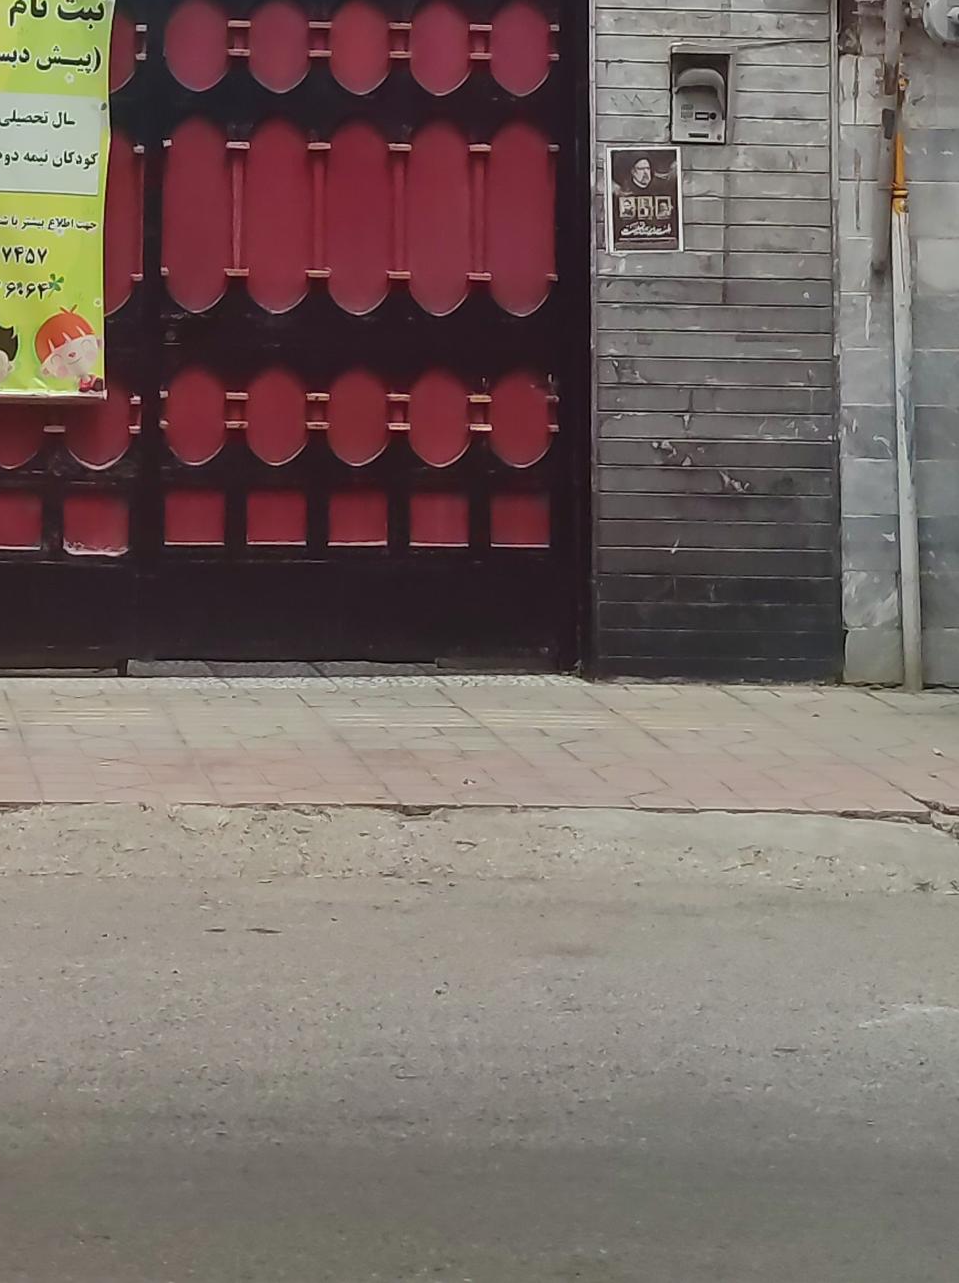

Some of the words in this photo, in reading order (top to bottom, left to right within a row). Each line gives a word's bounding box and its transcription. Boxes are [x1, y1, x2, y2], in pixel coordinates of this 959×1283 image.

[23, 148, 49, 167] نیمه
[52, 150, 99, 170] کودکان
[11, 215, 19, 228] با
[21, 216, 45, 230] بیشتر
[47, 217, 74, 231] اطلاع
[1, 246, 48, 264] ۷۴۵۷
